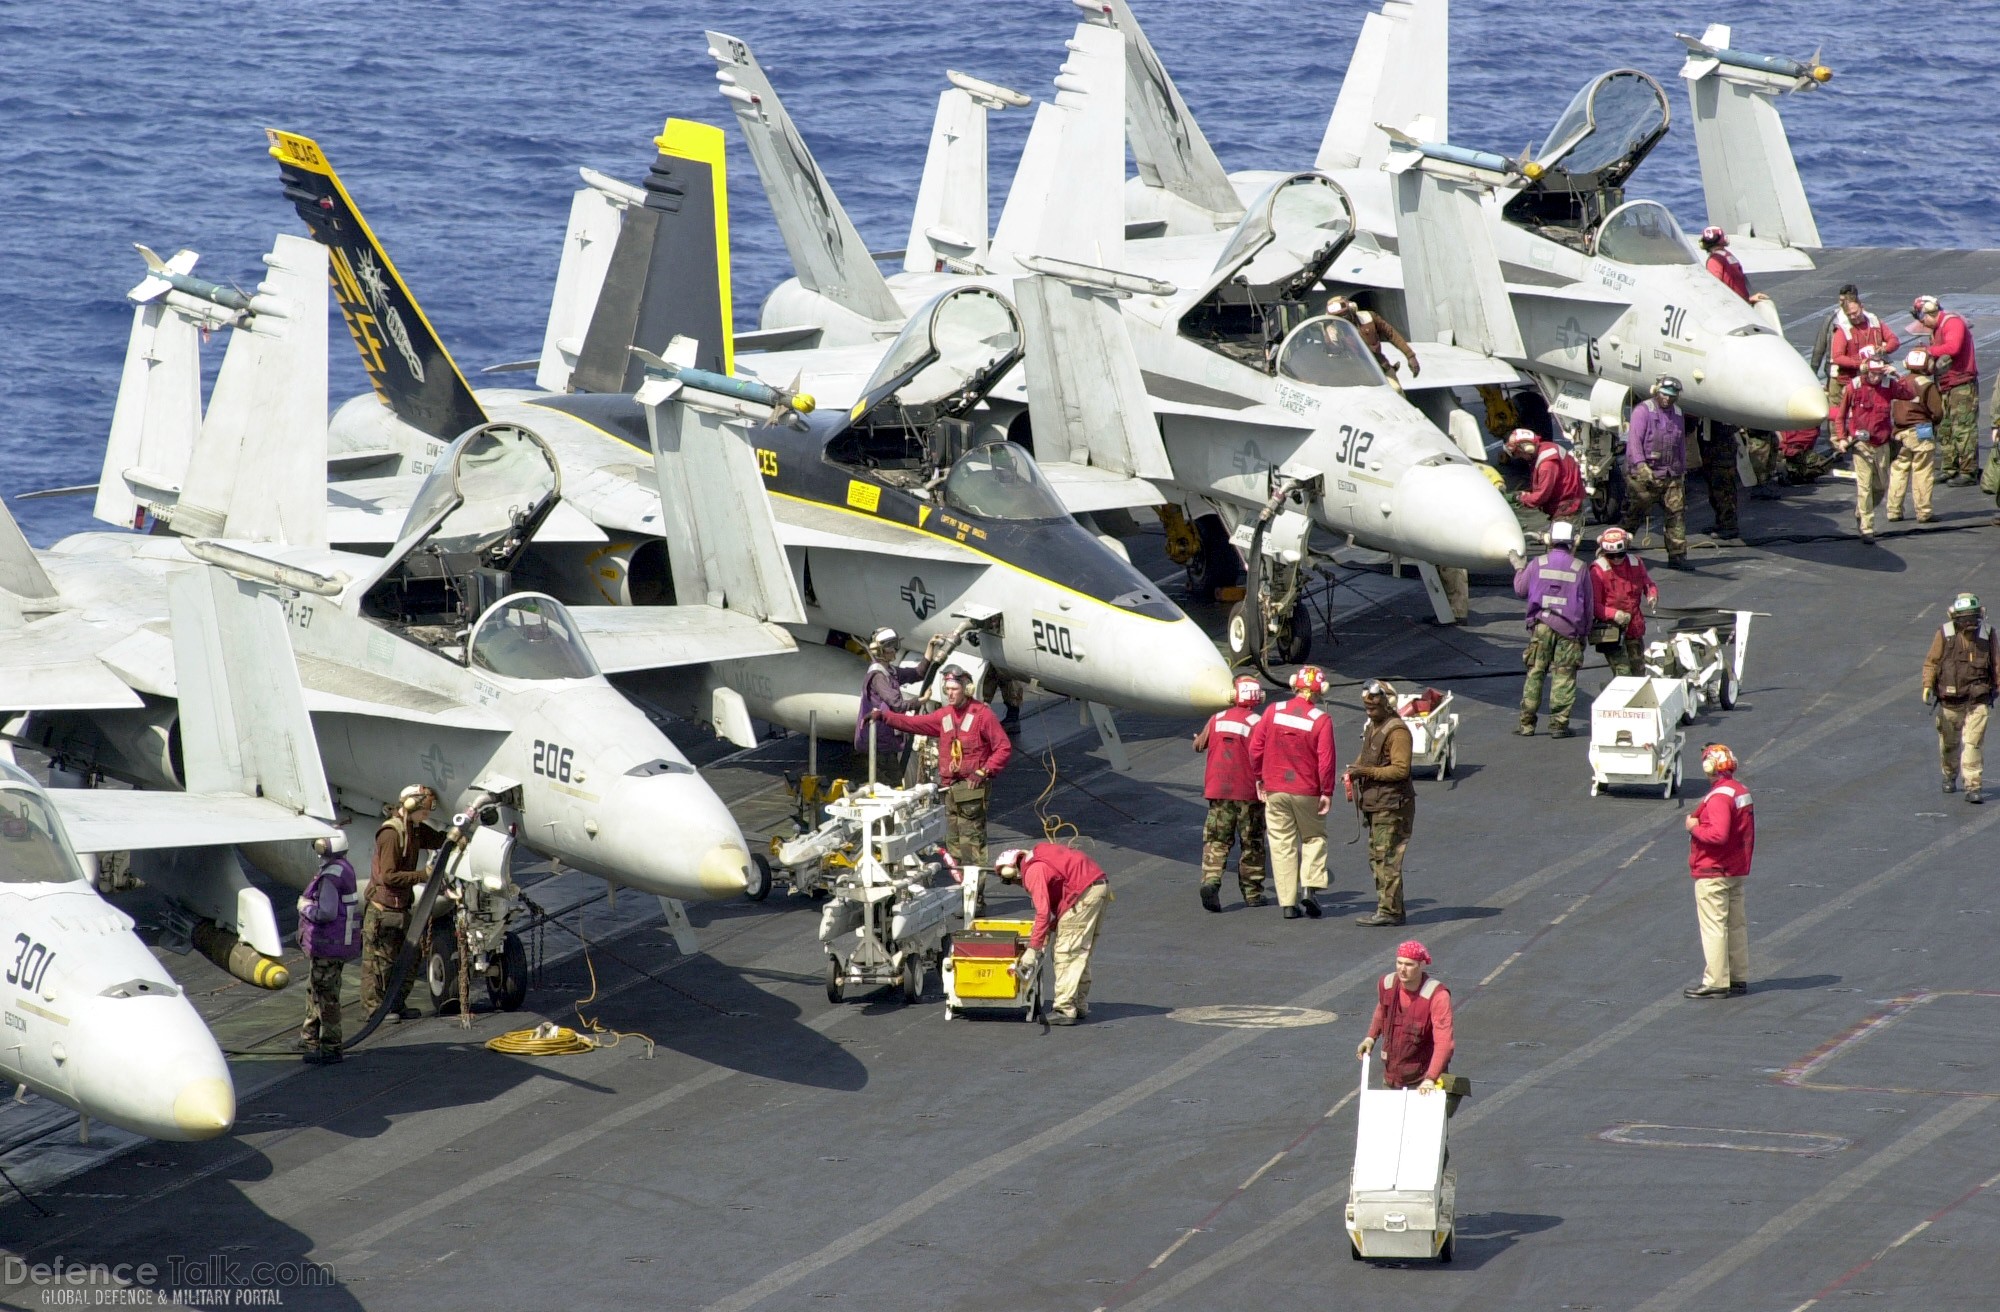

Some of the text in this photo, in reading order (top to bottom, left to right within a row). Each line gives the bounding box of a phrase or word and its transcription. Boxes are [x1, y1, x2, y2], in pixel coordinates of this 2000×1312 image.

[1660, 304, 1687, 340] 311
[757, 448, 778, 477] CES
[1336, 424, 1375, 469] 312
[281, 599, 313, 629] FA-27
[1032, 618, 1073, 660] 200
[533, 739, 574, 783] 206
[6, 932, 56, 994] 301
